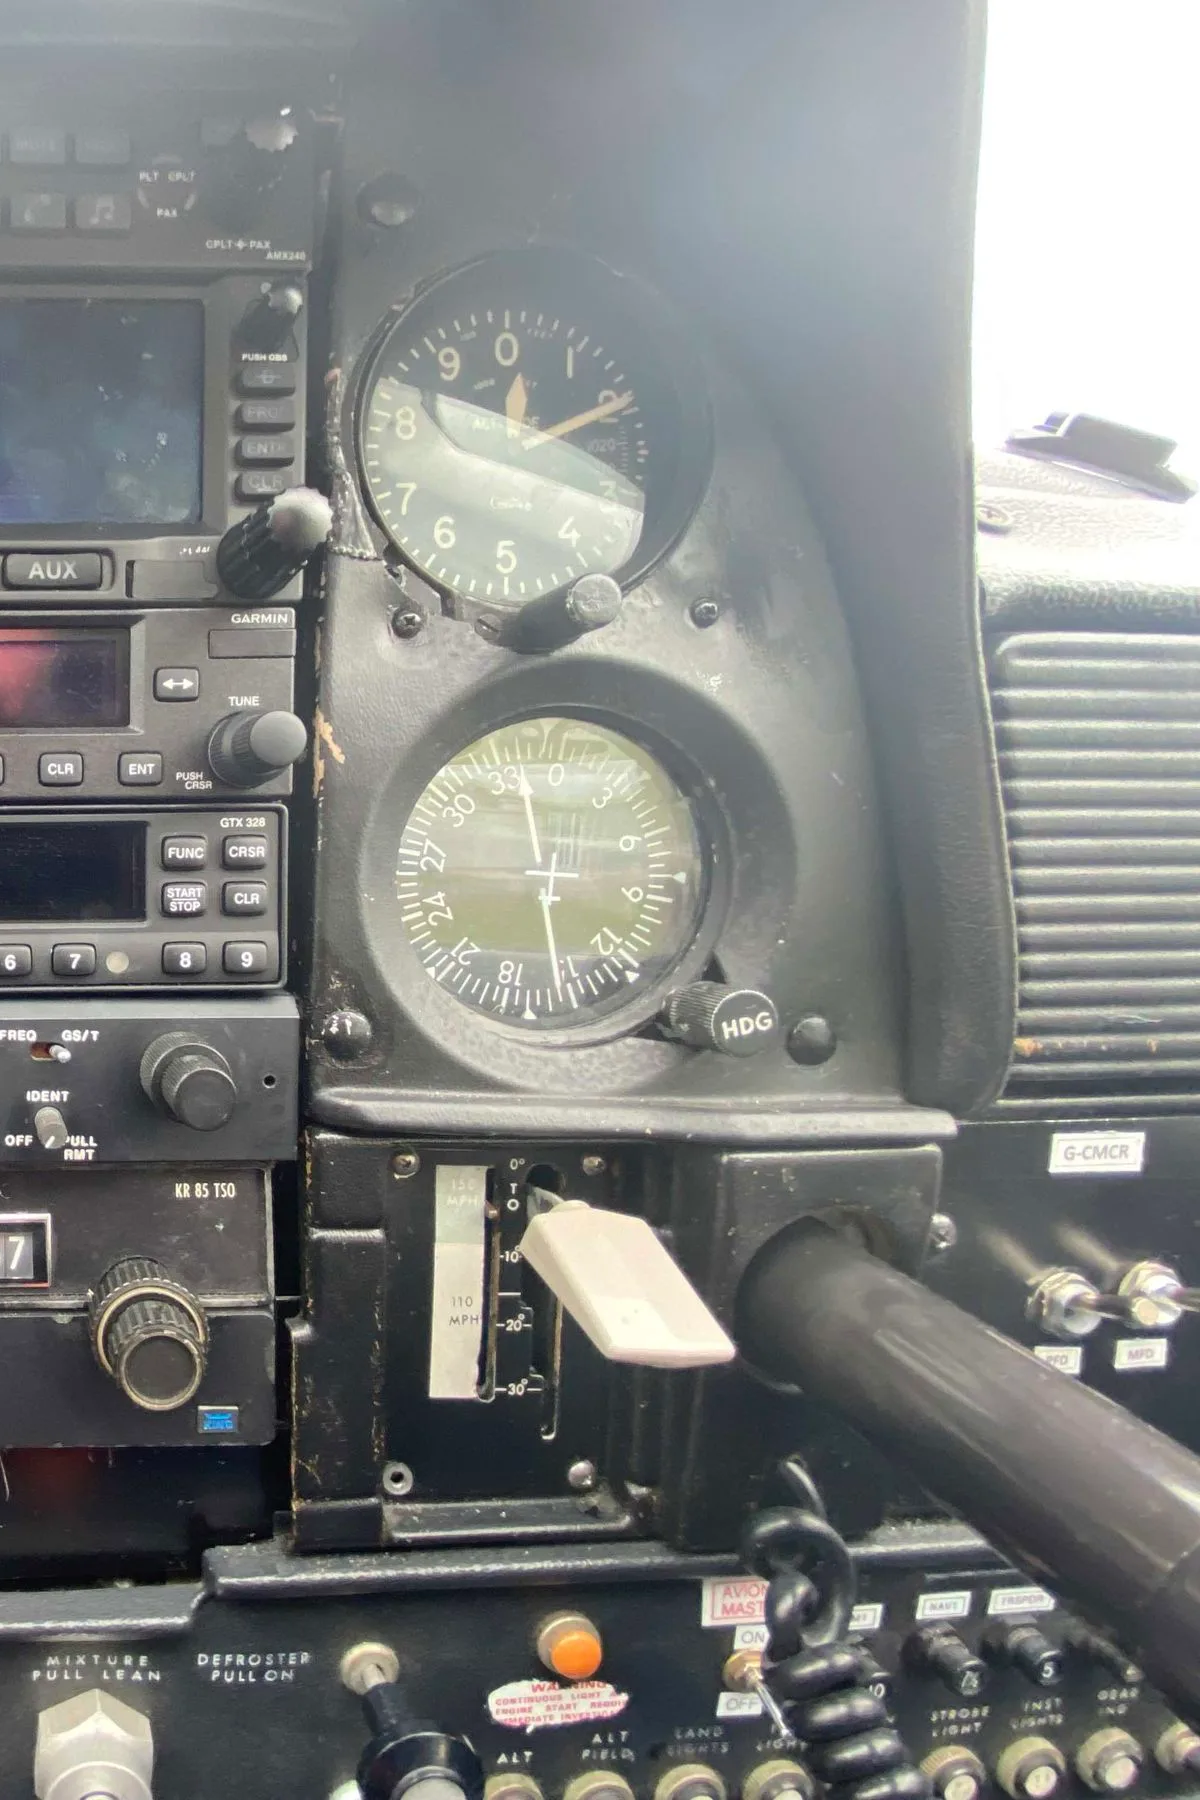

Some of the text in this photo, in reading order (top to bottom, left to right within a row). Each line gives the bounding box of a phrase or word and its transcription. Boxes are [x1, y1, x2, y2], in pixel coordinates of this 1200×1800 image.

[494, 331, 519, 367] 0
[241, 353, 266, 362] PUSH
[438, 347, 461, 381] 9
[395, 407, 416, 440] 8
[395, 482, 416, 515] 7
[433, 517, 456, 549] 6
[557, 517, 581, 547] 4
[495, 540, 517, 574] 5
[28, 560, 78, 580] AUX
[231, 613, 288, 625] GARMIN
[228, 696, 260, 706] TUNE
[47, 763, 74, 775] CLR
[128, 763, 155, 776] ENT
[548, 763, 564, 786] 0
[175, 772, 203, 782] PUSH
[184, 781, 213, 790] CRSR
[442, 794, 475, 828] 30
[220, 817, 266, 828] GTX 328
[167, 847, 204, 859] FUNC
[228, 845, 265, 857] CRSR
[420, 838, 446, 873] 27
[167, 887, 203, 899] START
[234, 893, 260, 905] CLR
[169, 901, 201, 912] STOP
[422, 891, 454, 926] 24
[590, 926, 623, 956] 12
[450, 936, 482, 966] 21
[4, 954, 17, 970] 6
[69, 953, 81, 970] 7
[179, 952, 191, 968] 8
[240, 951, 253, 968] 9
[499, 960, 523, 987] 18
[721, 1011, 773, 1040] HDG
[0, 1030, 99, 1042] FREQ GS/T
[26, 1091, 69, 1102] IDENT
[5, 1136, 33, 1147] OFF
[64, 1150, 95, 1161] RMT
[1063, 1144, 1129, 1161] G-CMCR
[175, 1182, 236, 1198] KR 85 TSO
[451, 1297, 473, 1308] 110
[449, 1315, 479, 1326] MPH
[1127, 1349, 1155, 1360] MFD
[741, 1630, 765, 1644] ON
[46, 1655, 149, 1666] MIXTURE
[197, 1652, 311, 1666] DEFROSTER
[32, 1670, 160, 1681] PULL LEAN
[212, 1669, 293, 1682] PULL ON
[496, 1691, 601, 1706] CONTINUOUS LIGHT
[1023, 1697, 1064, 1712] INST
[545, 1703, 578, 1713] START
[930, 1705, 990, 1722] STROBE
[932, 1722, 982, 1738] LIGHT
[591, 1731, 629, 1744] ALT
[496, 1752, 534, 1764] ALT
